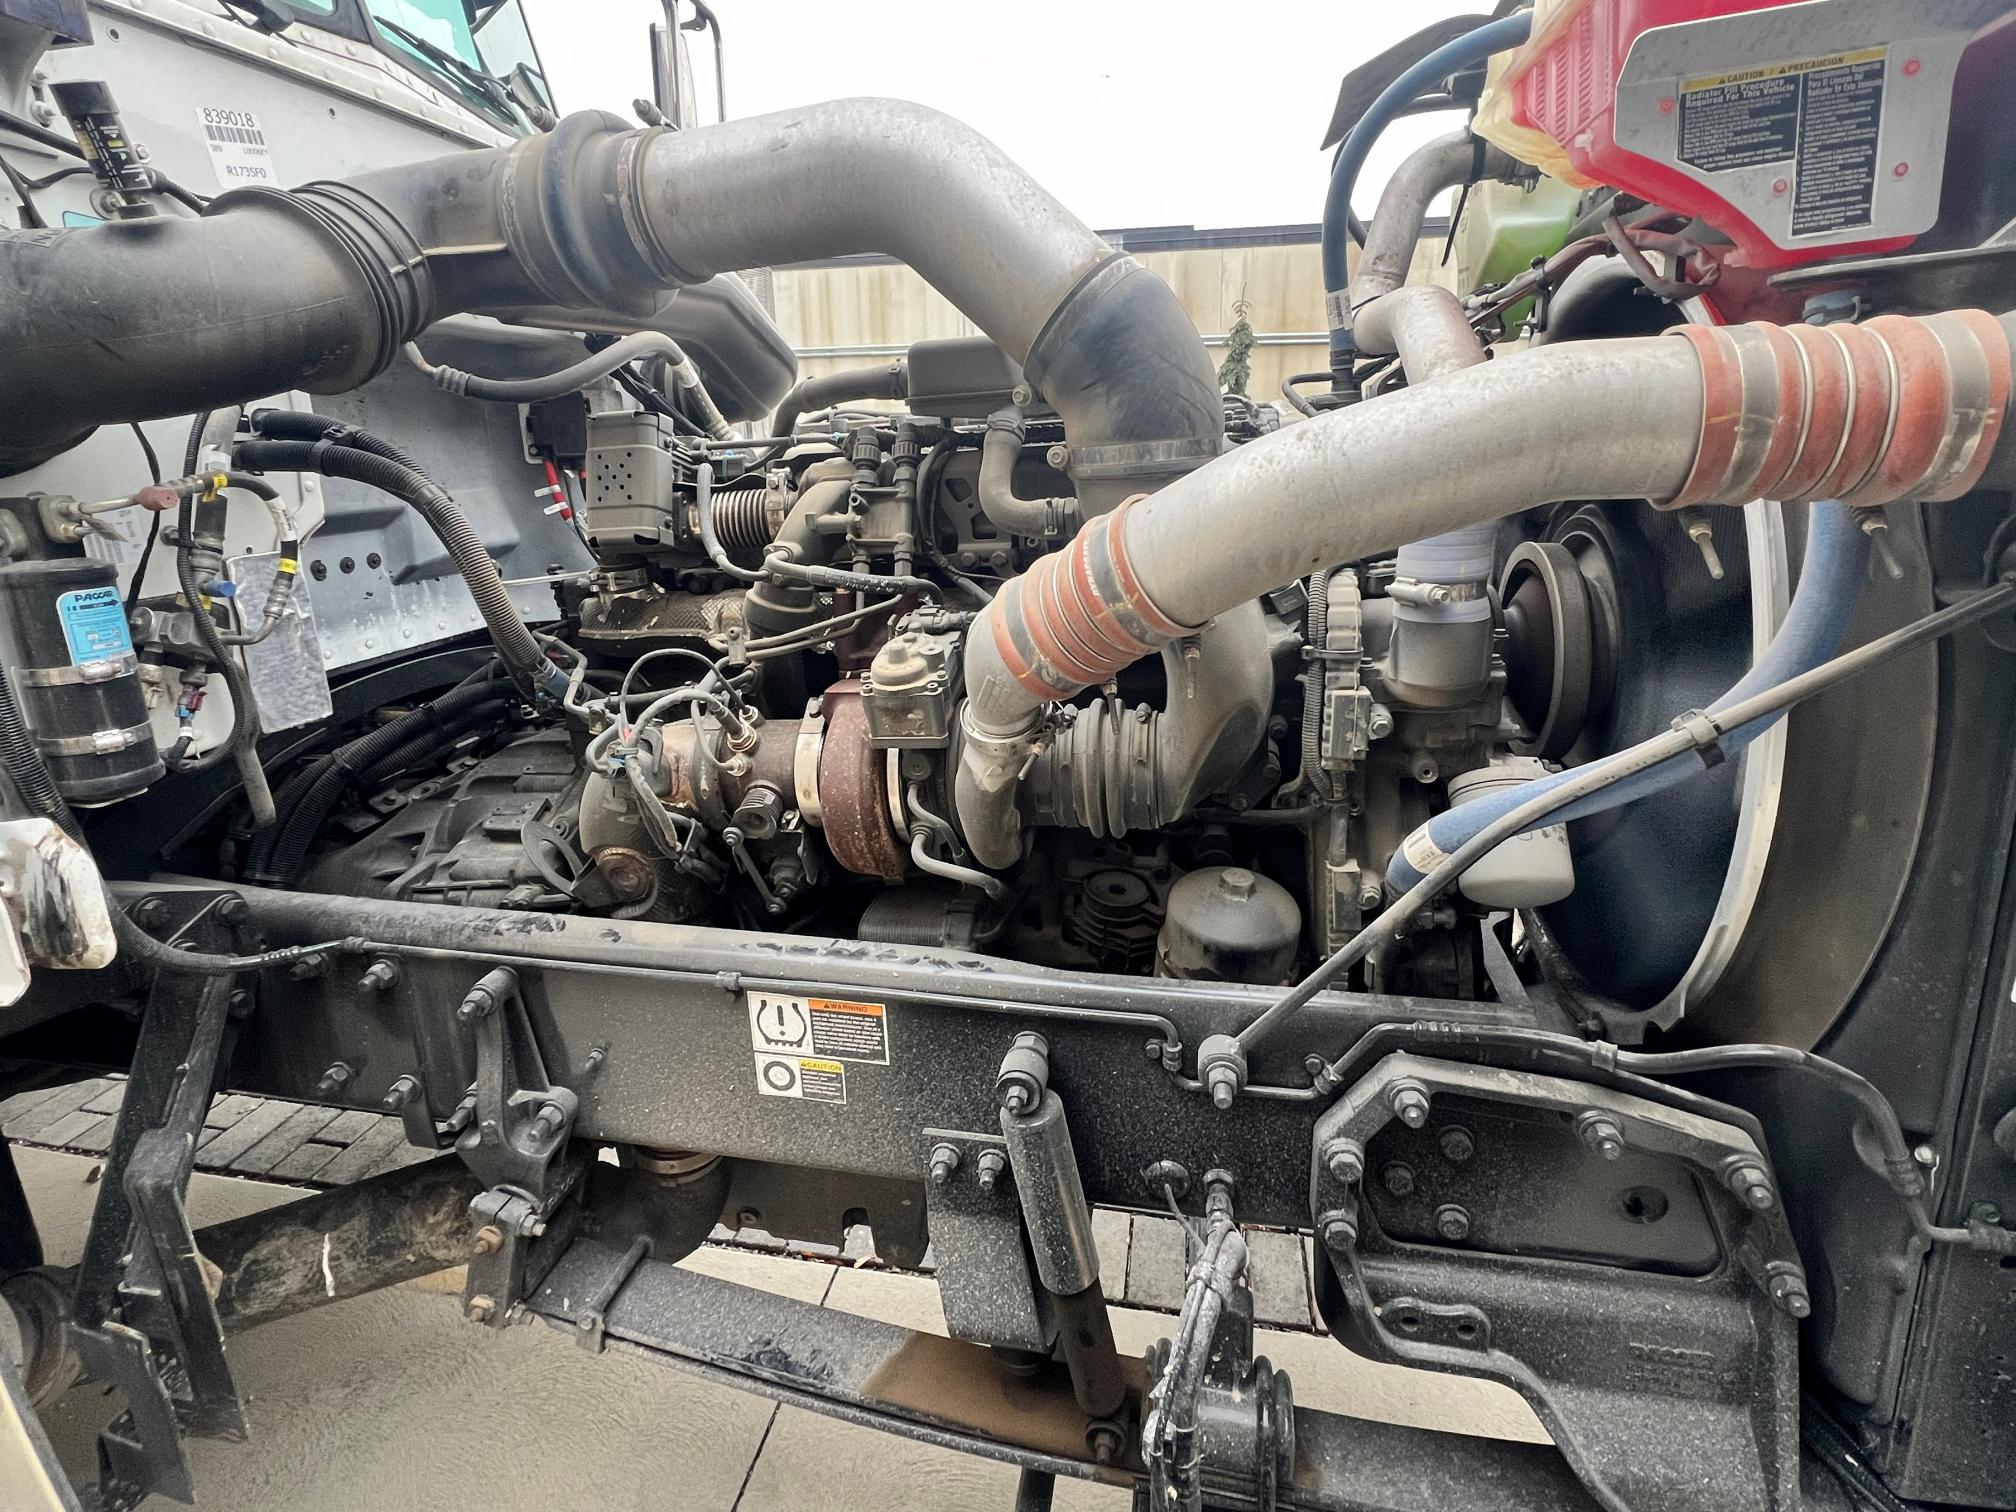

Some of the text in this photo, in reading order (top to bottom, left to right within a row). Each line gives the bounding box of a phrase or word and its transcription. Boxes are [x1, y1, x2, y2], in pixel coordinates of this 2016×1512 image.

[1727, 70, 1764, 83] CAUTION
[1686, 79, 1785, 100] Radiator Fill Procedure
[1686, 84, 1795, 108] Required For This Vehicle
[203, 107, 255, 128] 839018
[74, 590, 113, 602] PACCAR
[830, 1003, 868, 1012] WARNING
[807, 1062, 842, 1071] CAUTION
